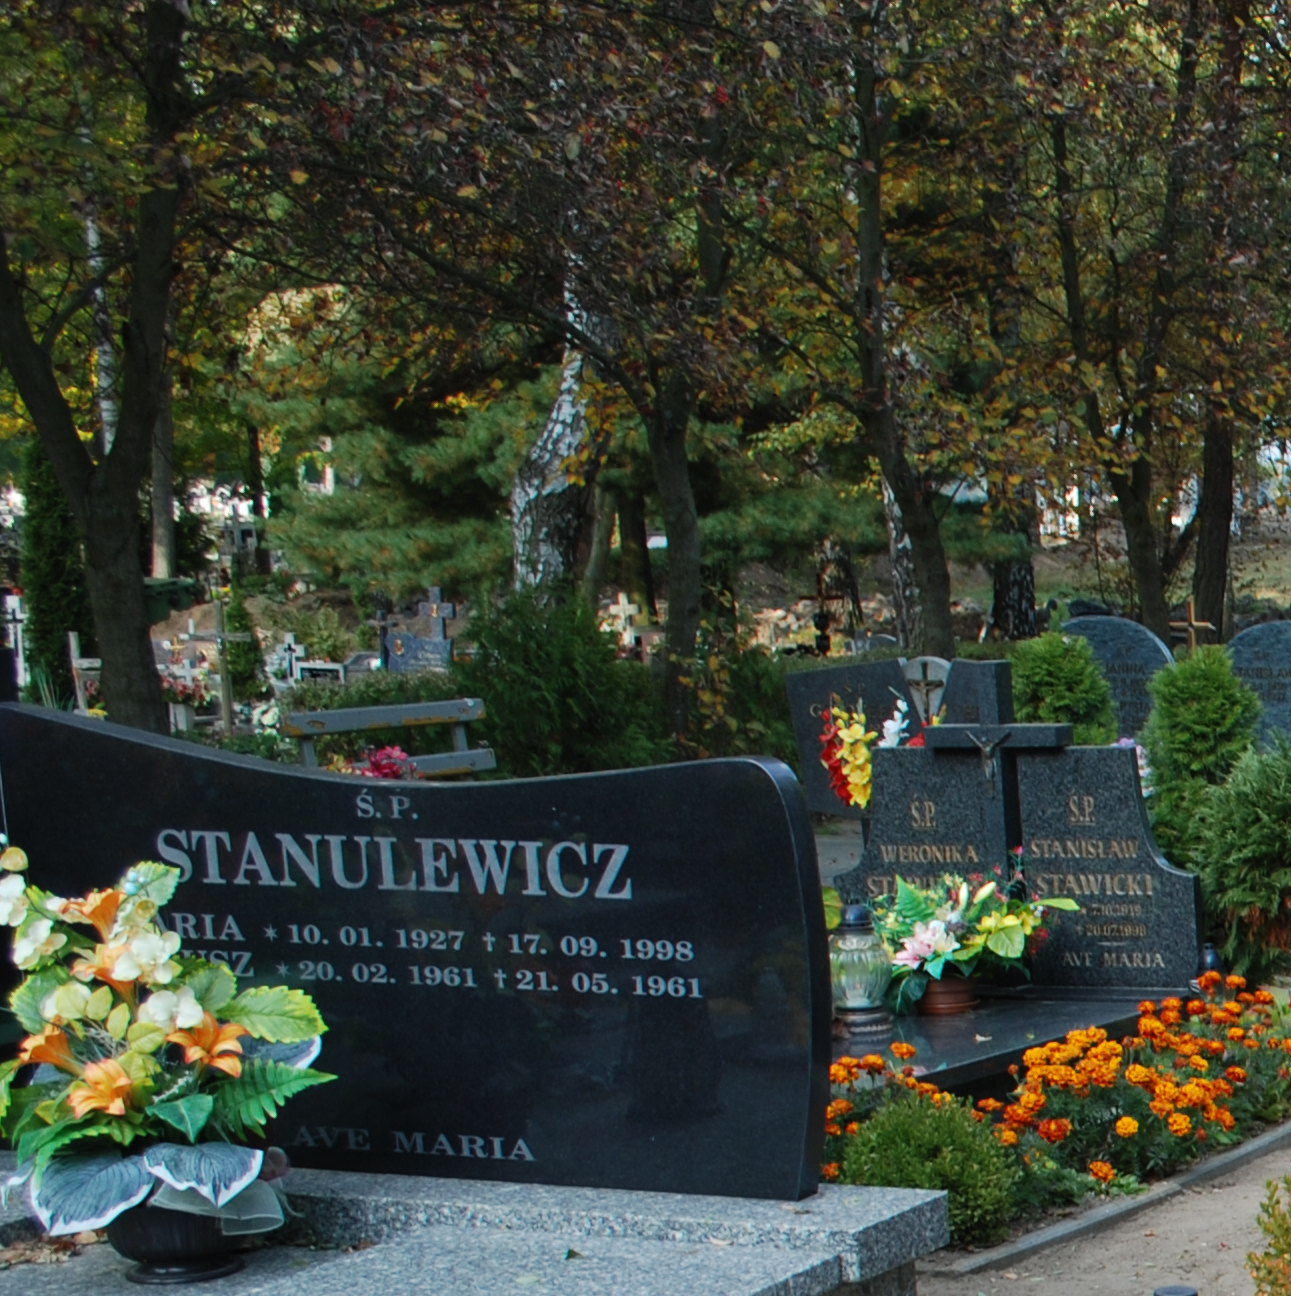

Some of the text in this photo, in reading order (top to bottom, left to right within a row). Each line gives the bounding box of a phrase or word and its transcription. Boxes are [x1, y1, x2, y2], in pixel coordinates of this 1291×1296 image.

[156, 828, 633, 899] STANULEWICZ
[880, 844, 980, 863] WERONIKA
[1036, 873, 1153, 895] STAWICKI
[288, 924, 329, 945] 10.
[339, 926, 384, 947] 01.
[396, 928, 465, 950] 1927
[508, 934, 548, 954] 17.
[560, 936, 607, 958] 09.
[620, 938, 695, 961] 1998
[1063, 951, 1165, 968] AVE MARIA
[300, 961, 703, 998] 20. 02. 1961 21. 05. 1961
[293, 1125, 537, 1162] AVE MARIA
